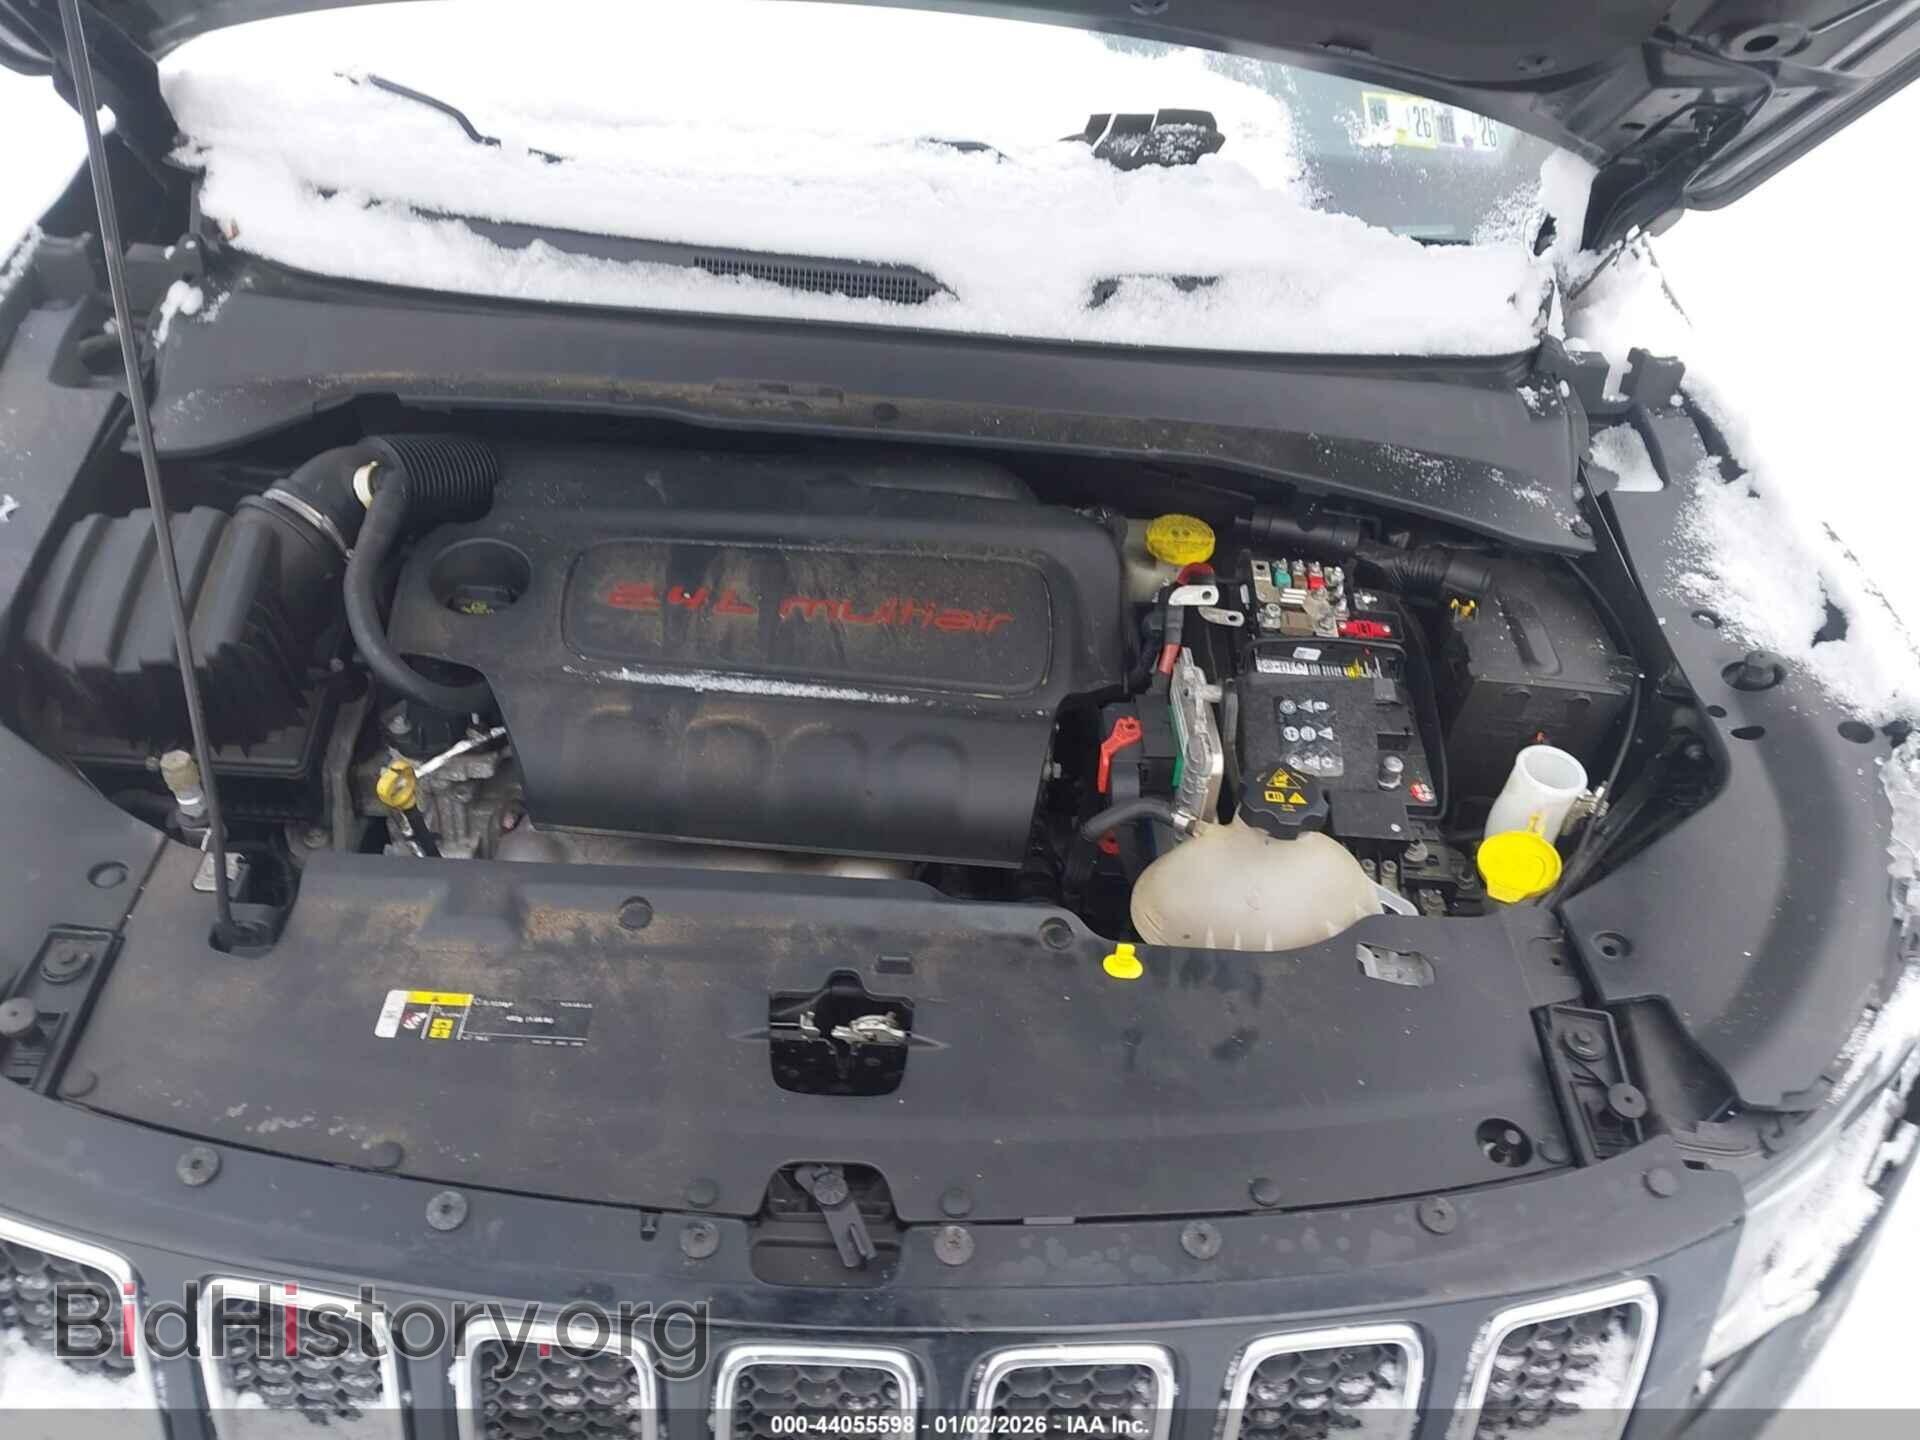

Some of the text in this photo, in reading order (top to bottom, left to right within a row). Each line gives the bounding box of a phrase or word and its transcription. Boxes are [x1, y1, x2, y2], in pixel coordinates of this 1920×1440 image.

[1412, 105, 1432, 138] 26
[1478, 115, 1497, 147] 26
[778, 593, 1013, 631] multiair
